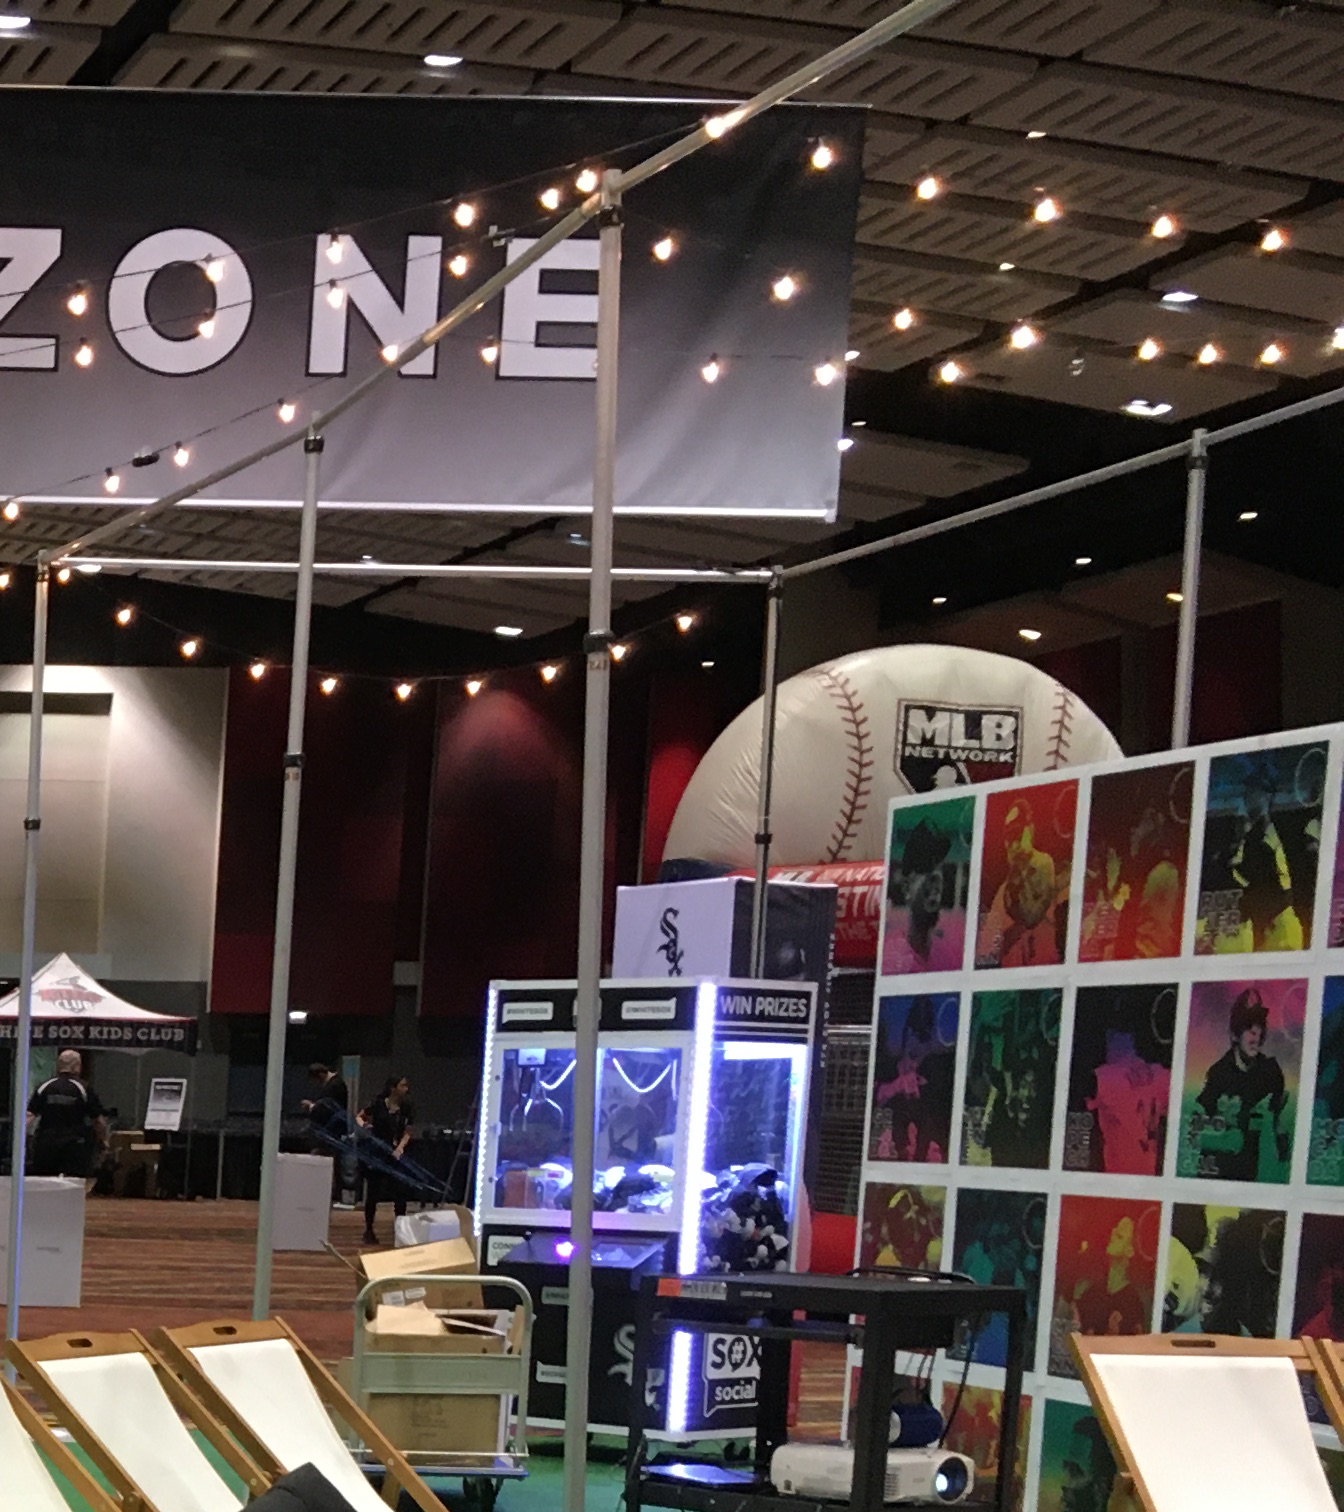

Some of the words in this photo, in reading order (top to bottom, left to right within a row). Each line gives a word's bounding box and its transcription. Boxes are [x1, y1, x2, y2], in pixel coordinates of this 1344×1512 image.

[905, 709, 1017, 751] MLB
[904, 746, 1013, 763] NETWORK
[719, 994, 753, 1014] WIN
[755, 996, 809, 1019] PRIZES
[48, 1026, 85, 1039] SOX
[88, 1026, 132, 1041] KIDS
[136, 1027, 185, 1042] CLUB
[714, 1380, 756, 1401] social
